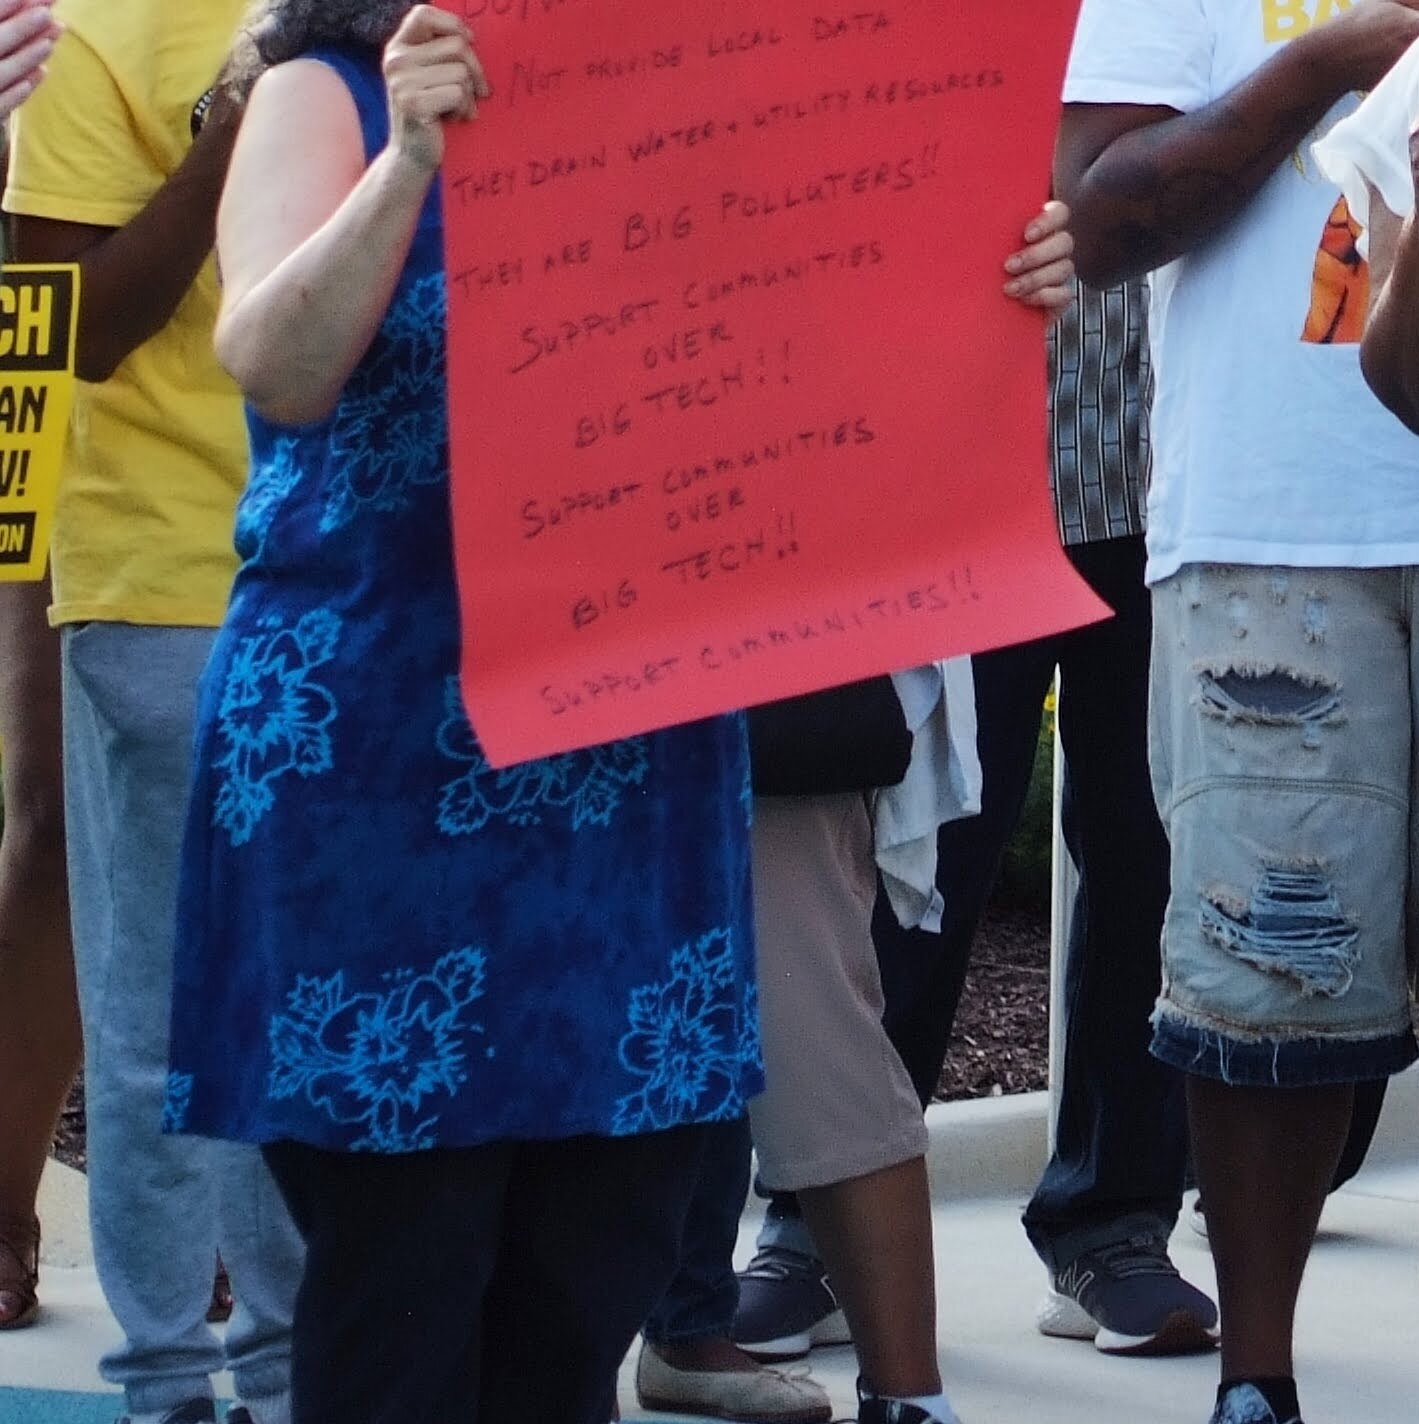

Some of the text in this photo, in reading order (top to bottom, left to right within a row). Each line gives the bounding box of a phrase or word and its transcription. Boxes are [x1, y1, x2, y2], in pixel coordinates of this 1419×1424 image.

[707, 27, 782, 58] LOCAL
[813, 8, 890, 42] DATA
[453, 166, 519, 206] THEY
[527, 145, 608, 188] DRAIN
[626, 120, 715, 162] WATER
[752, 88, 851, 130] UTILITY
[863, 68, 1005, 107] RESOURCES
[454, 256, 524, 292] THEY
[543, 238, 593, 274] ARE
[622, 205, 693, 254] BIG
[641, 320, 734, 370] OVER
[574, 401, 632, 450] BIG
[521, 481, 643, 542] SUPPORT
[665, 485, 746, 533] OVER
[569, 577, 639, 631] BIG
[539, 656, 680, 716] SUPPORT
